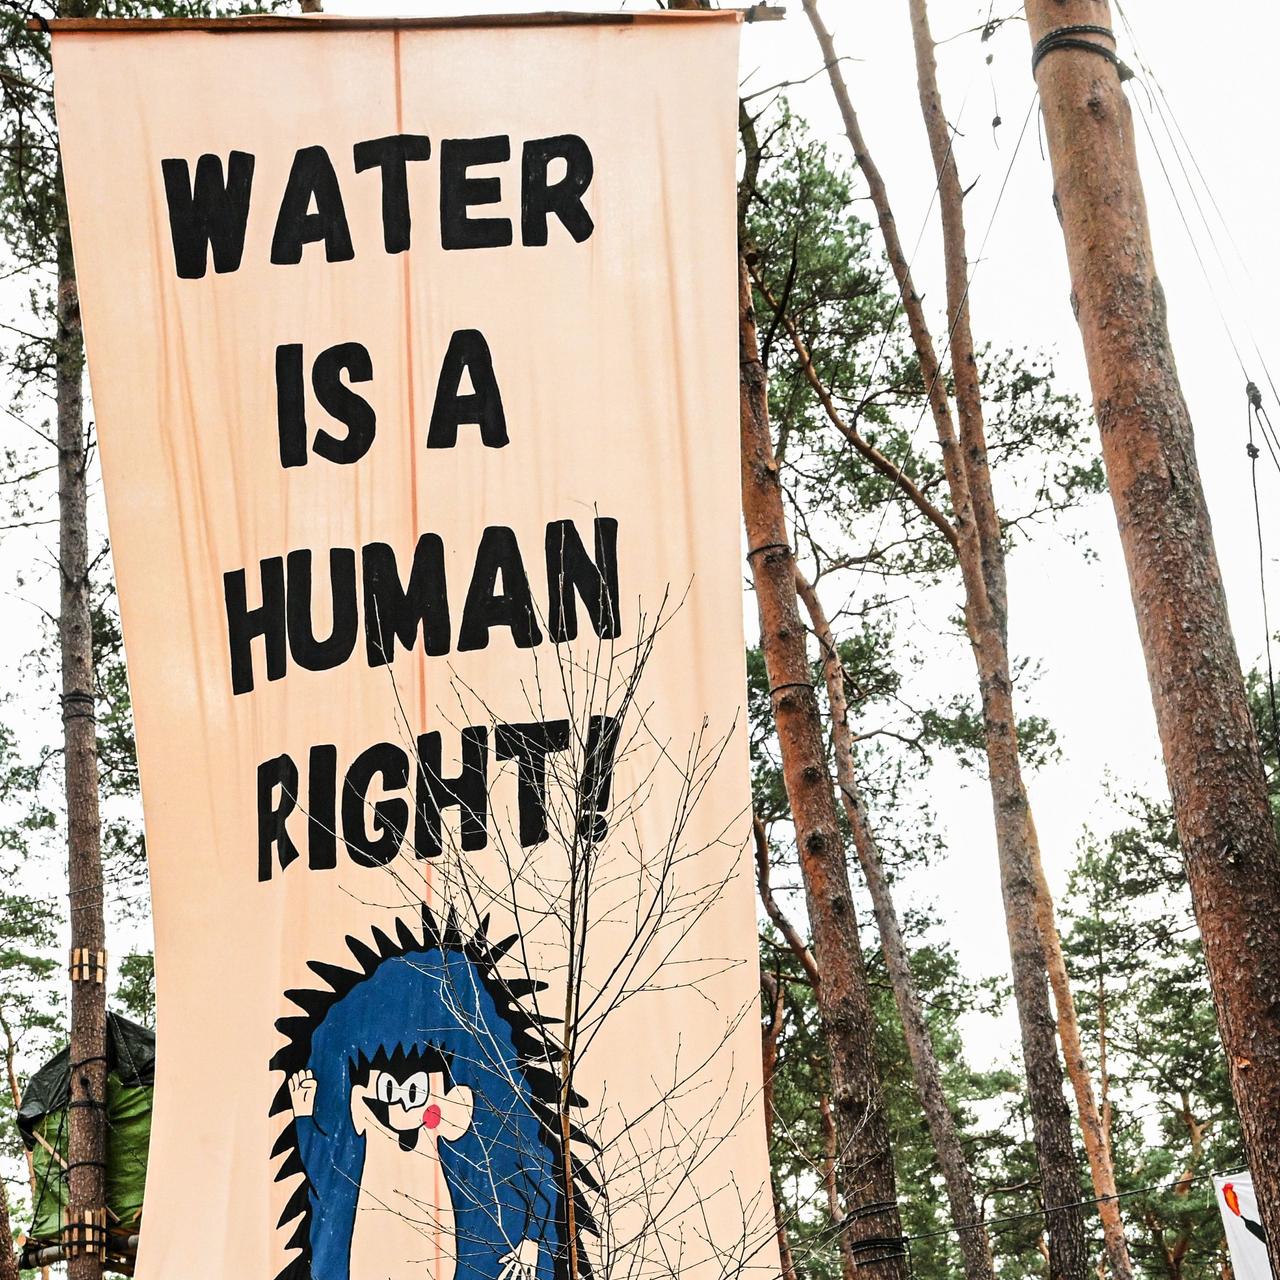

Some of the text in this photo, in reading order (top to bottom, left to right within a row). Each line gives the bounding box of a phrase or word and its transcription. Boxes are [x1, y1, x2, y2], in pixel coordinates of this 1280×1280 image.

[161, 133, 595, 280] WATER
[275, 328, 510, 468] IS A
[223, 517, 622, 696] HUMAN
[256, 716, 621, 882] RIGHT!
